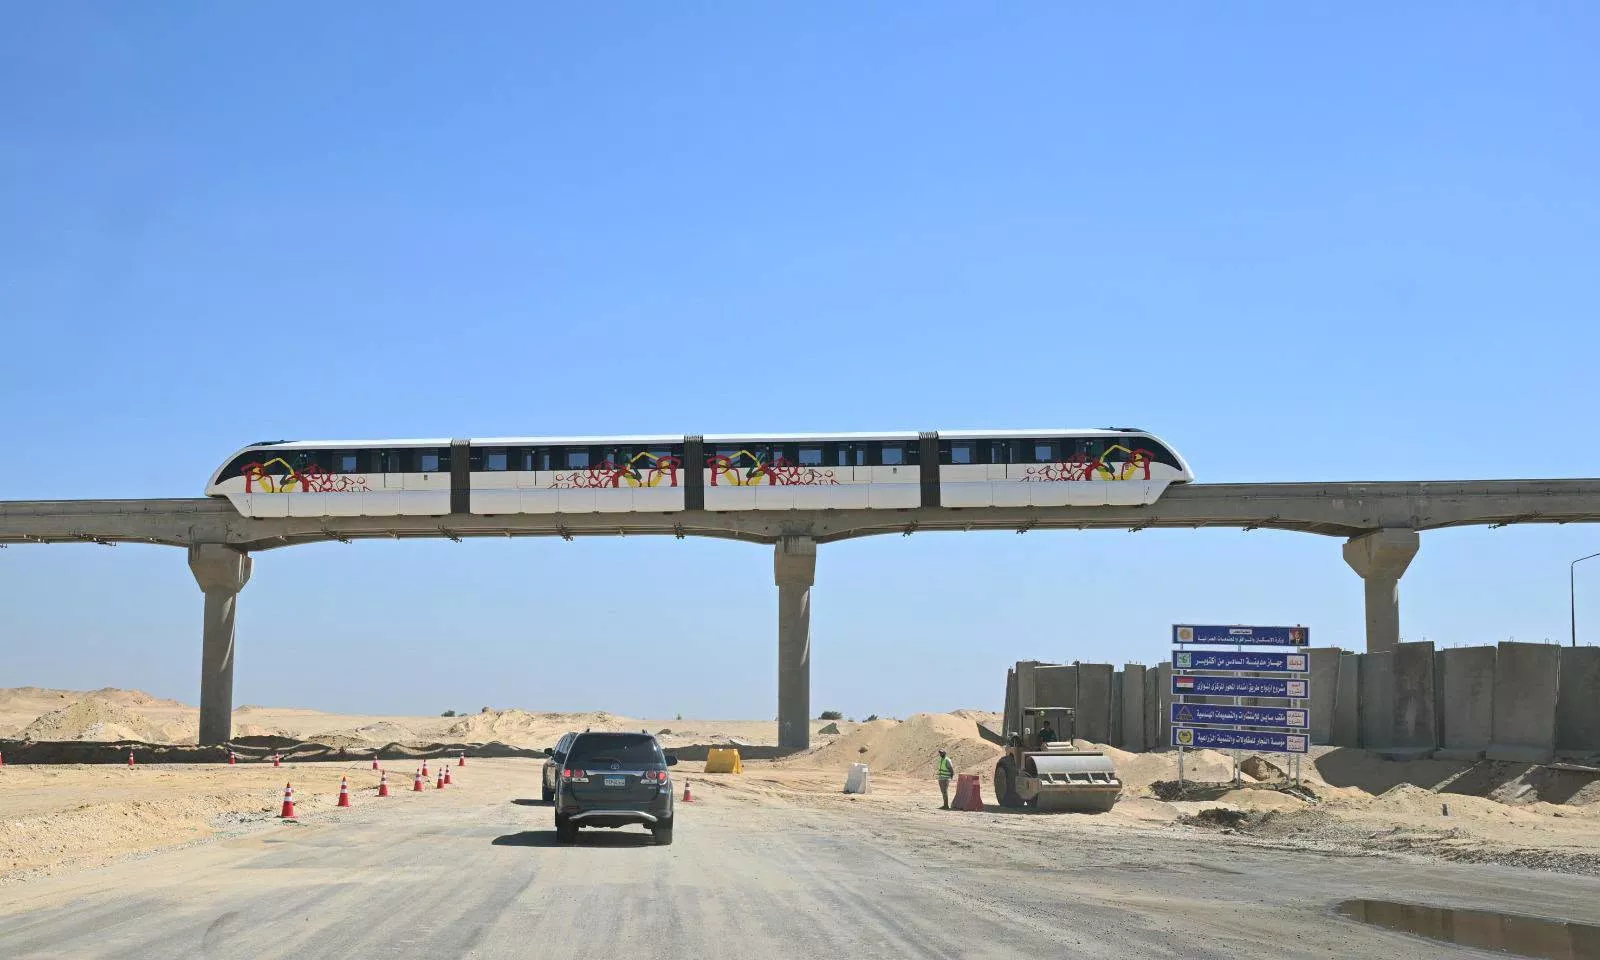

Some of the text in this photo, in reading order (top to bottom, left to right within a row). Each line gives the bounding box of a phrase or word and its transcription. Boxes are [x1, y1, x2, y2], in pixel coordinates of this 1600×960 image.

[1218, 658, 1225, 666] من
[1226, 658, 1245, 666] السادس
[1246, 657, 1266, 667] مدينة
[1266, 658, 1284, 668] جهاز
[1248, 682, 1260, 692] طريق
[1272, 683, 1286, 694] مشروع
[1274, 713, 1286, 722] مكتب
